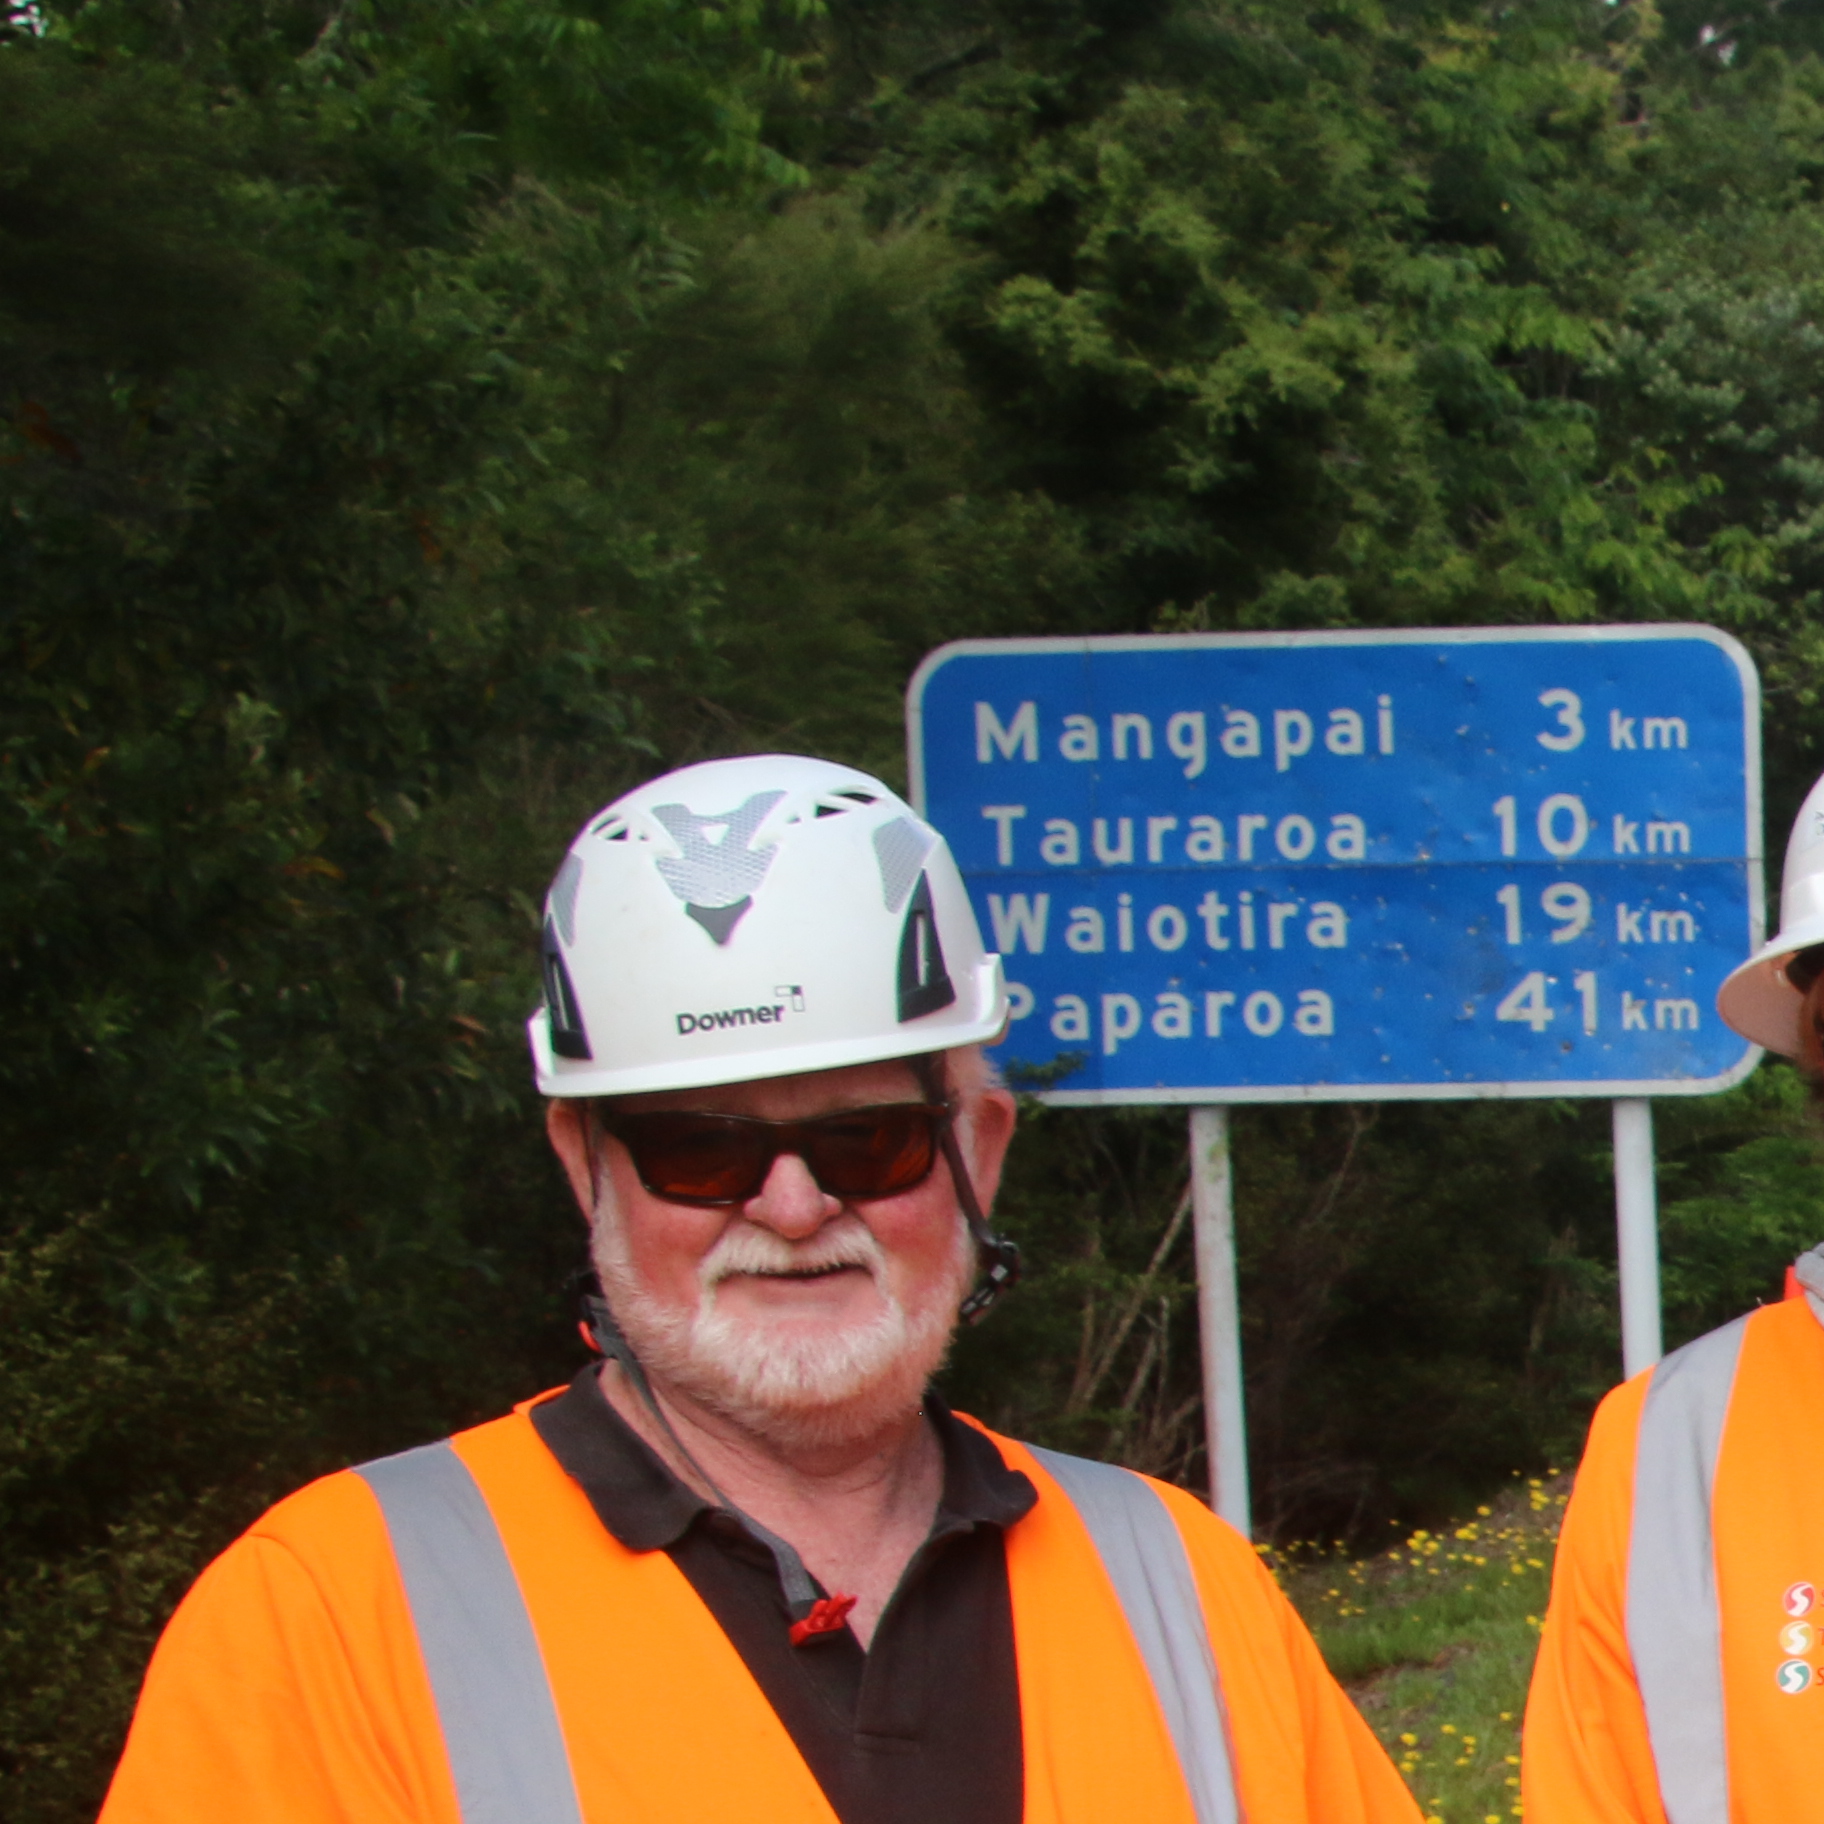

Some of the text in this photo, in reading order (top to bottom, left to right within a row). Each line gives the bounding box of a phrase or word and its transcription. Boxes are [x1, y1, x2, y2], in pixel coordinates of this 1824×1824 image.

[974, 688, 1690, 780] Mangapai 3 km
[981, 794, 1692, 867] Tauraroa 10 km
[986, 881, 1696, 955] Waiotira 19 km
[676, 1002, 785, 1035] Downer
[1006, 971, 1701, 1055] Paparoa 41 km
